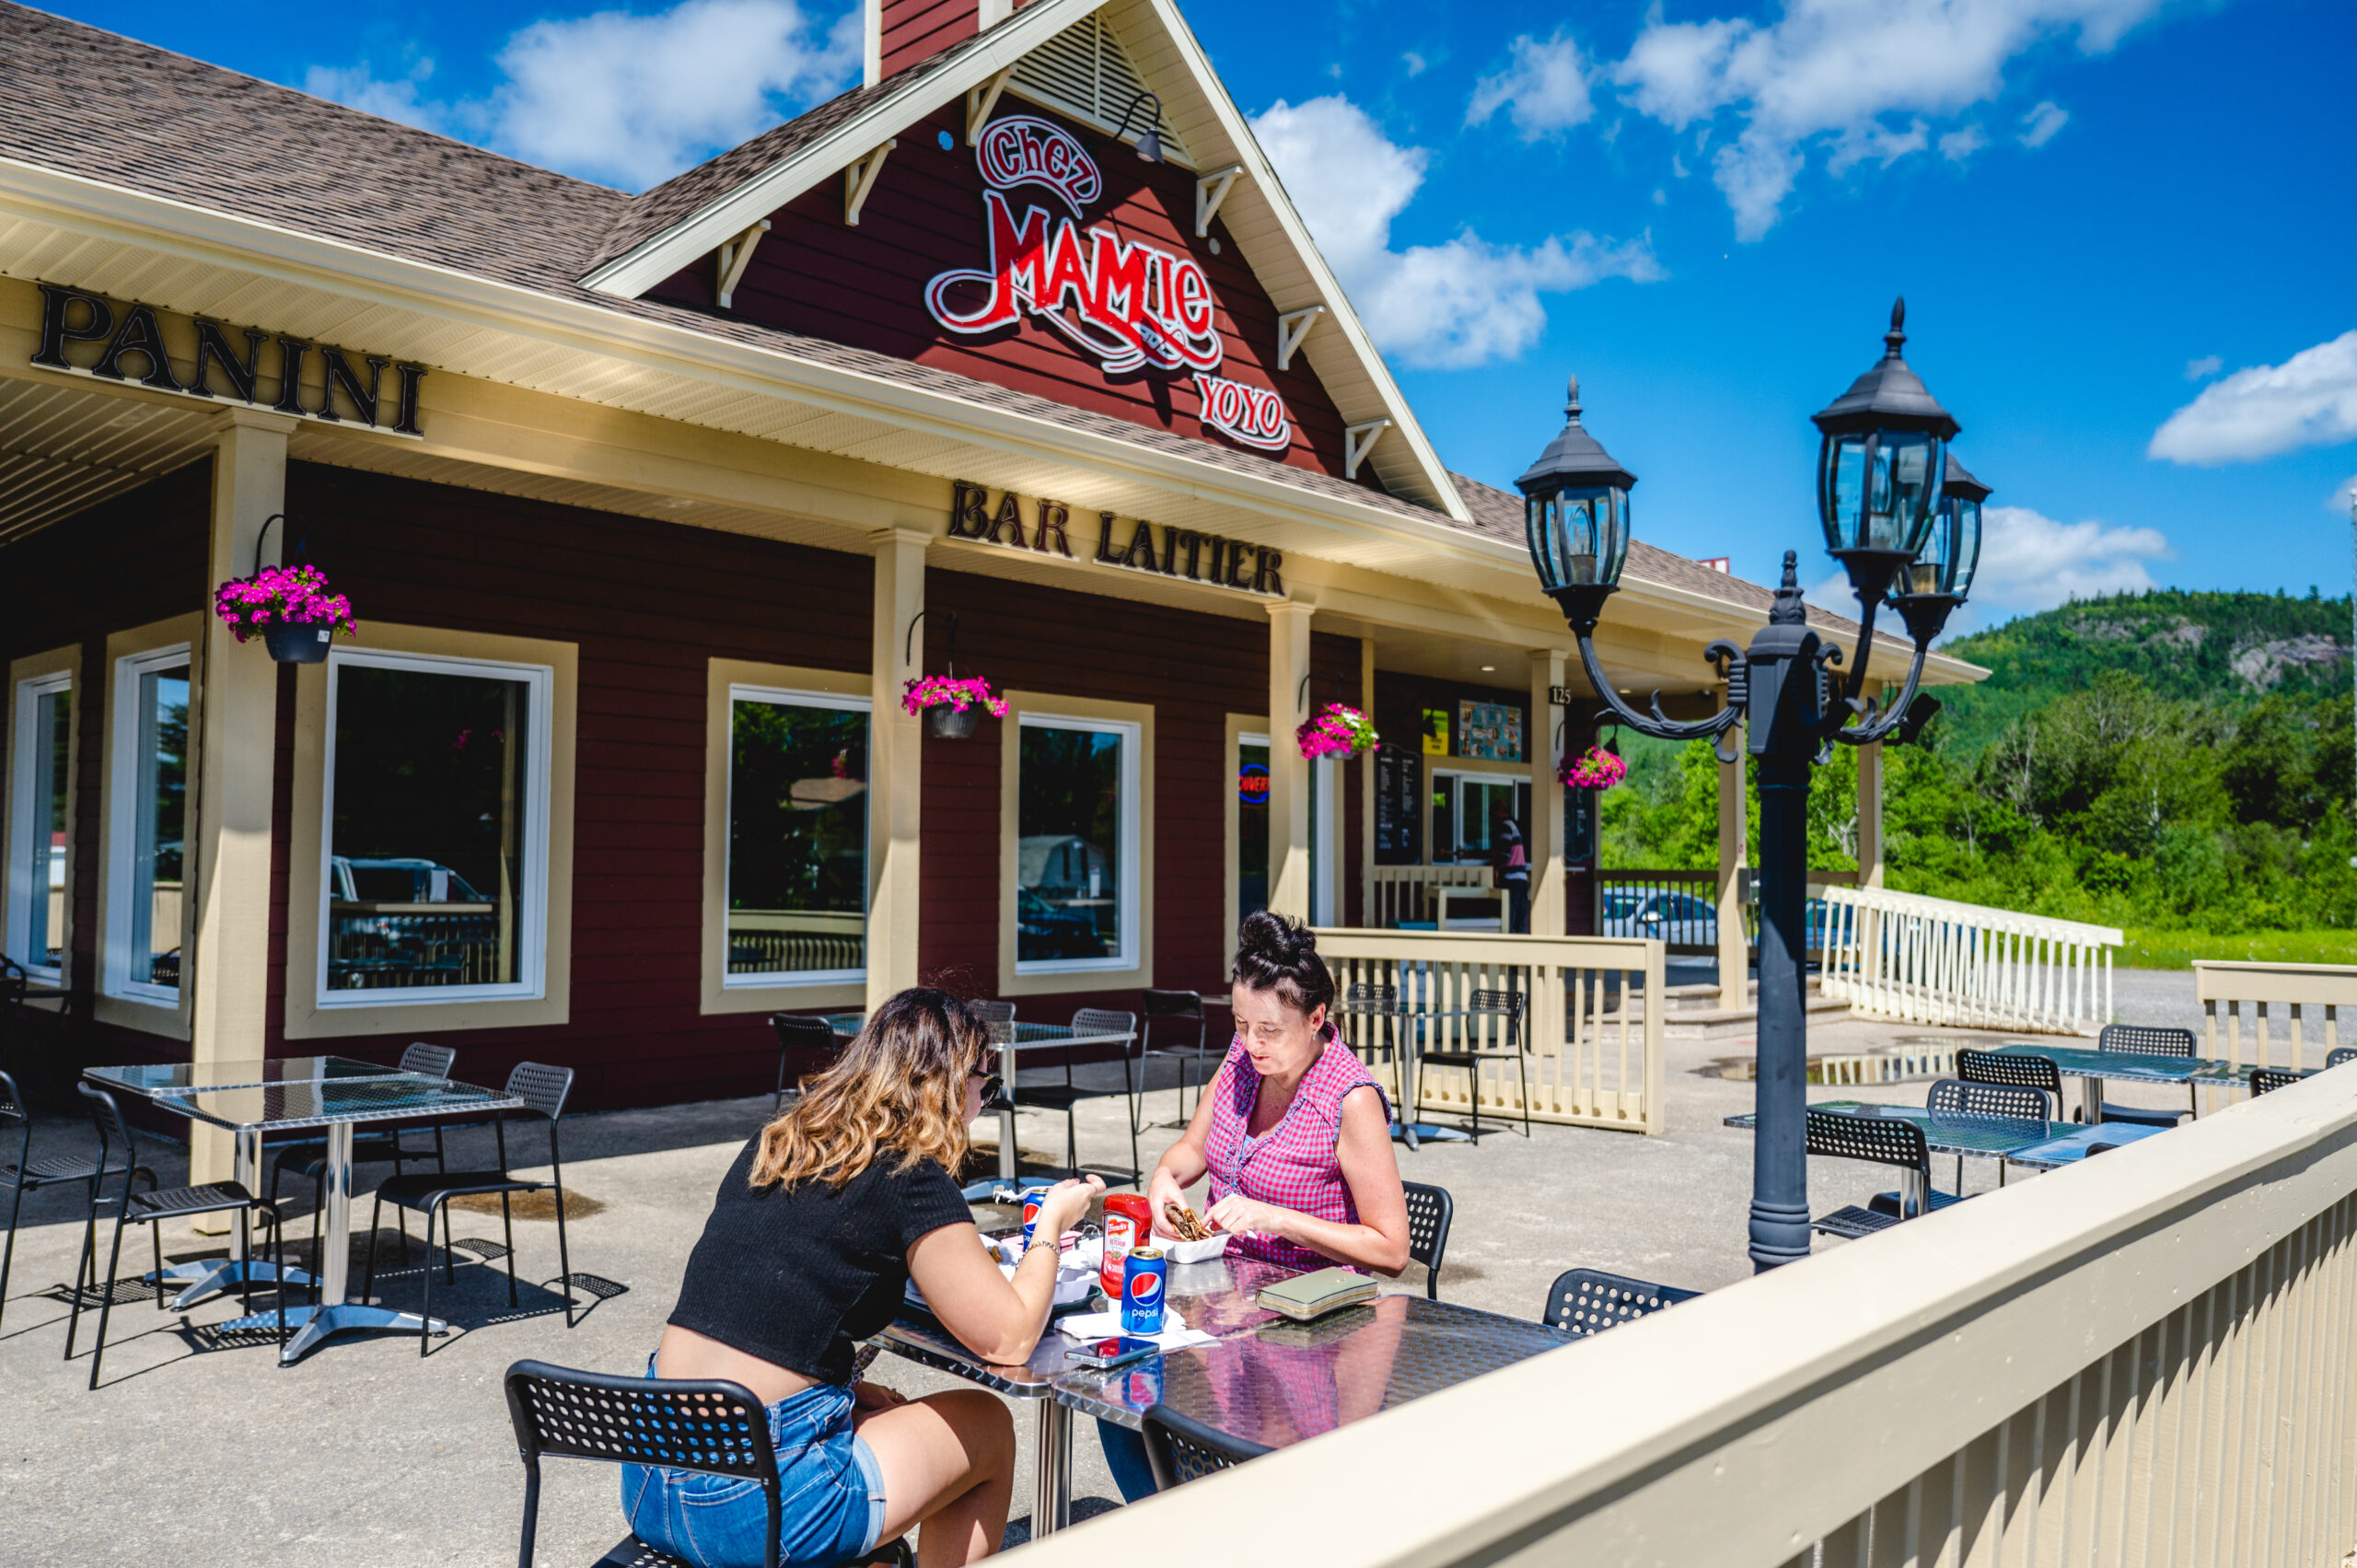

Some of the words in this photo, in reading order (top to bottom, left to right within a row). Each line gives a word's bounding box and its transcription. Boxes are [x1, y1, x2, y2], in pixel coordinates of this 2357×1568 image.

[989, 125, 1095, 202] Chez
[31, 285, 428, 437] PANINI
[1195, 372, 1285, 439] YOYO
[949, 482, 1074, 559] BAR
[1097, 512, 1285, 597] LAITIER
[1553, 688, 1571, 704] 125
[1109, 1238, 1126, 1248] KETCHUP
[1132, 1307, 1159, 1319] pepsi
